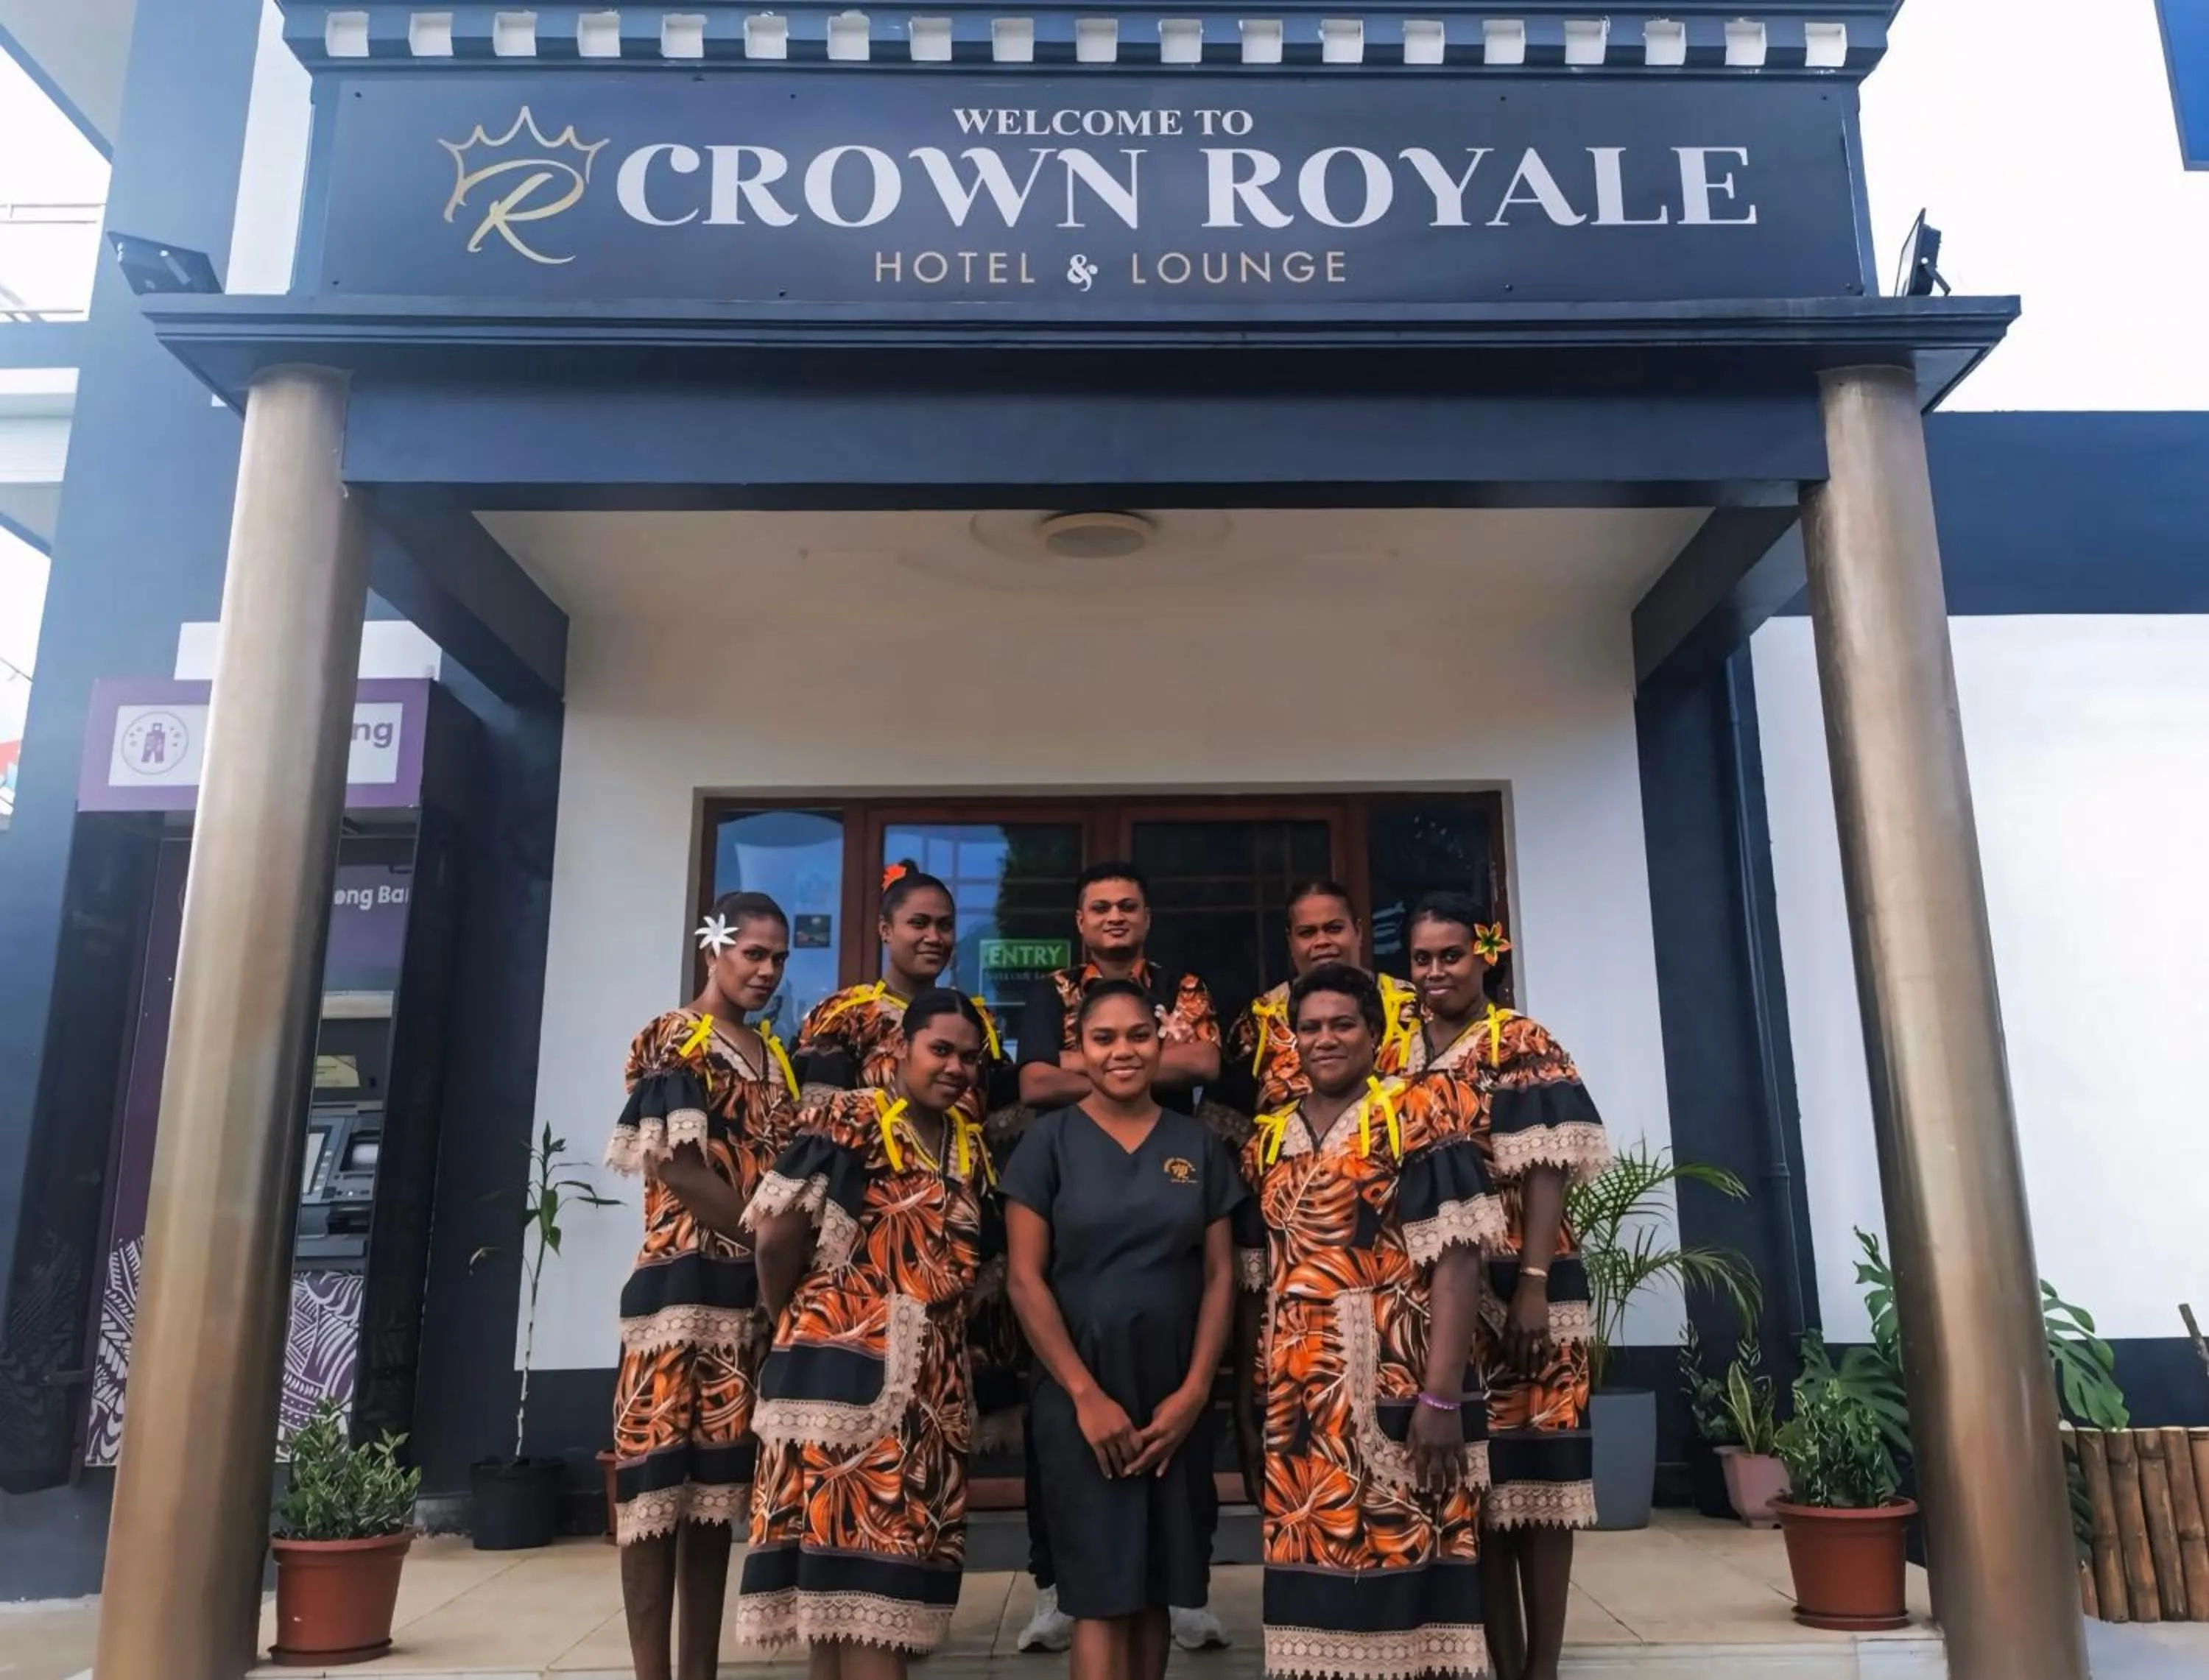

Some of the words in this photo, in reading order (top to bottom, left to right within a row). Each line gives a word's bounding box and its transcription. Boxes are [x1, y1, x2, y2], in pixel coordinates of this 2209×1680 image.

[953, 109, 1183, 136] WELCOME
[1194, 109, 1254, 135] TO
[616, 143, 1148, 230] CROWN
[1199, 145, 1758, 229] ROYALE
[875, 251, 1035, 284] HOTEL
[1066, 253, 1099, 292] &
[1132, 251, 1346, 284] LOUNGE
[988, 945, 1063, 967] ENTRY
